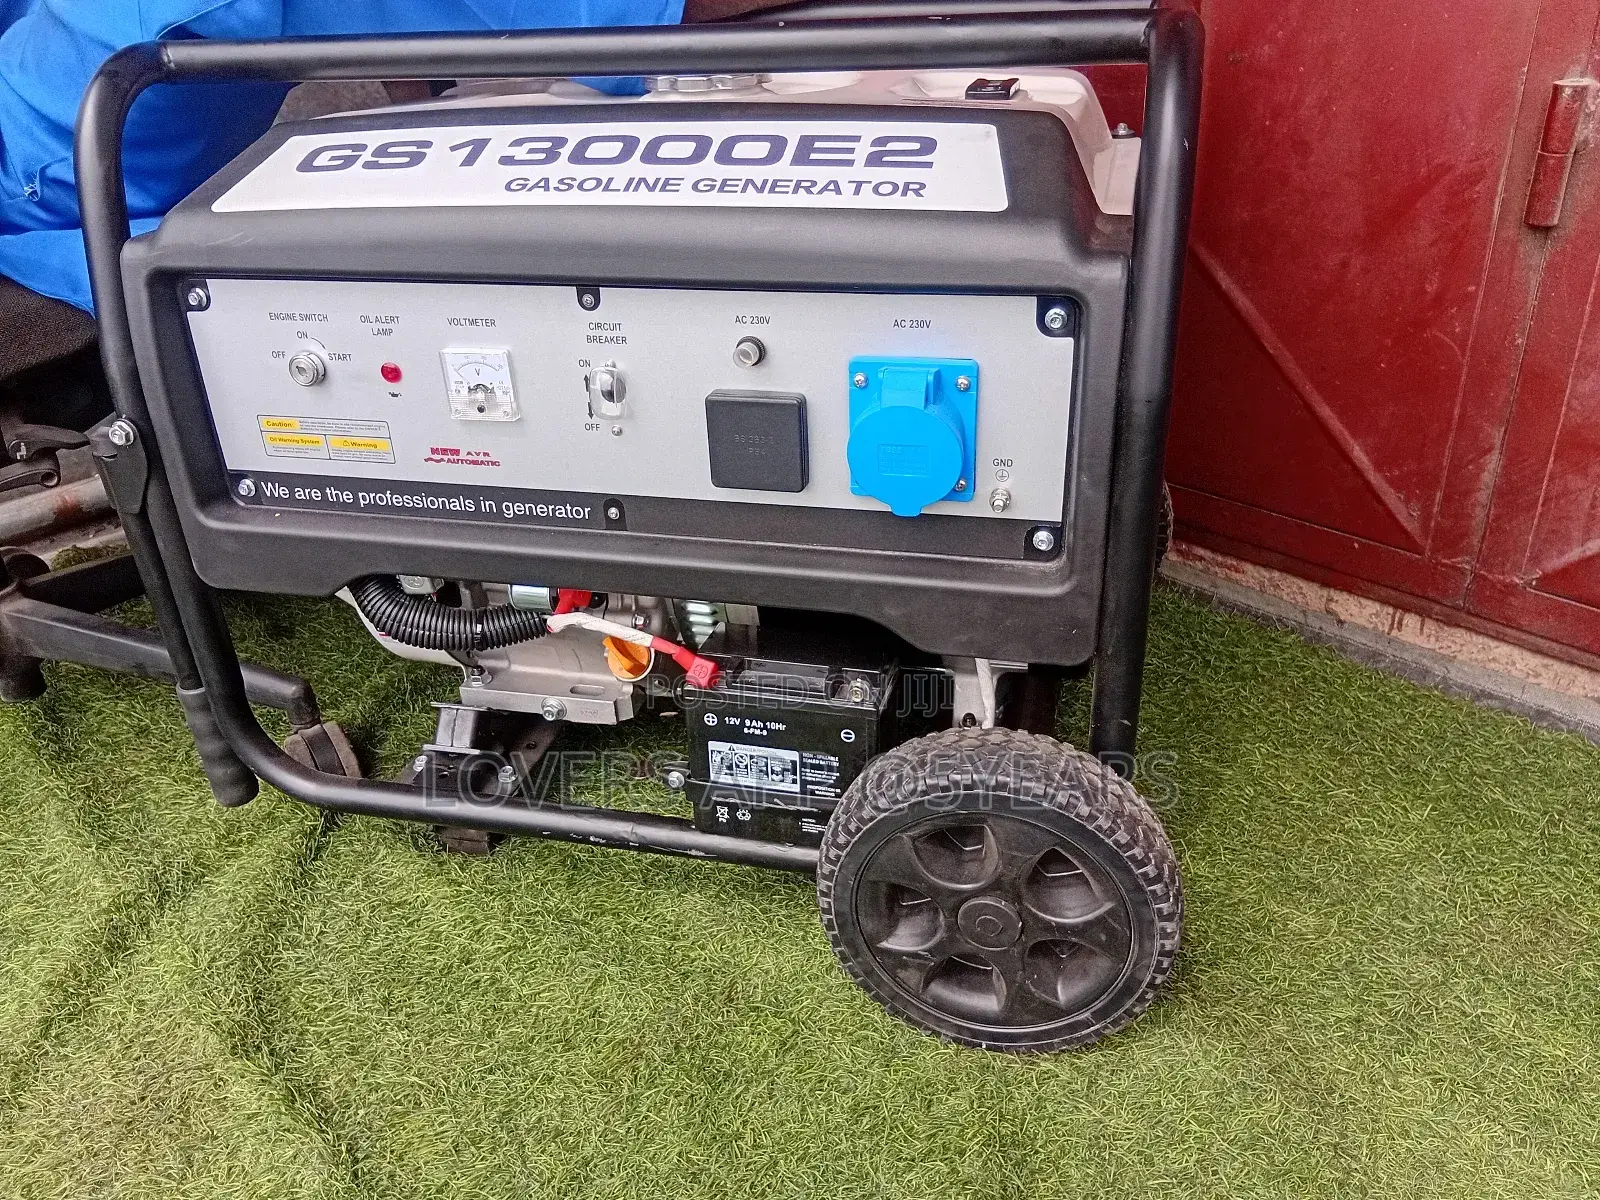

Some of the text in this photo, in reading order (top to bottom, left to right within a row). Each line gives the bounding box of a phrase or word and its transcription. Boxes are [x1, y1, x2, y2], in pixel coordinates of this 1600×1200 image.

[505, 176, 927, 198] GASOLINE GENERATOR
[269, 312, 329, 322] ENGINE SWITCH
[360, 315, 400, 324] OIL ALERT
[735, 315, 771, 326] AC 230V
[447, 317, 497, 328] VOLTMETER
[588, 322, 622, 332] CIRCUIT
[893, 319, 932, 330] AC 230V
[296, 331, 308, 339] ON
[372, 328, 394, 337] LAMP
[586, 335, 628, 345] BREAKER
[272, 351, 286, 359] OFF
[328, 352, 352, 362] START
[578, 359, 591, 368] ON
[475, 368, 481, 376] V
[584, 423, 601, 432] OFF
[350, 441, 378, 449] Warning
[430, 447, 491, 458] NEW AVR
[446, 457, 501, 467] AUTOMATIC
[992, 458, 1013, 468] GND
[260, 481, 591, 520] We are the professionals in generator
[724, 716, 741, 726] 12V
[765, 721, 787, 731] 10Hr
